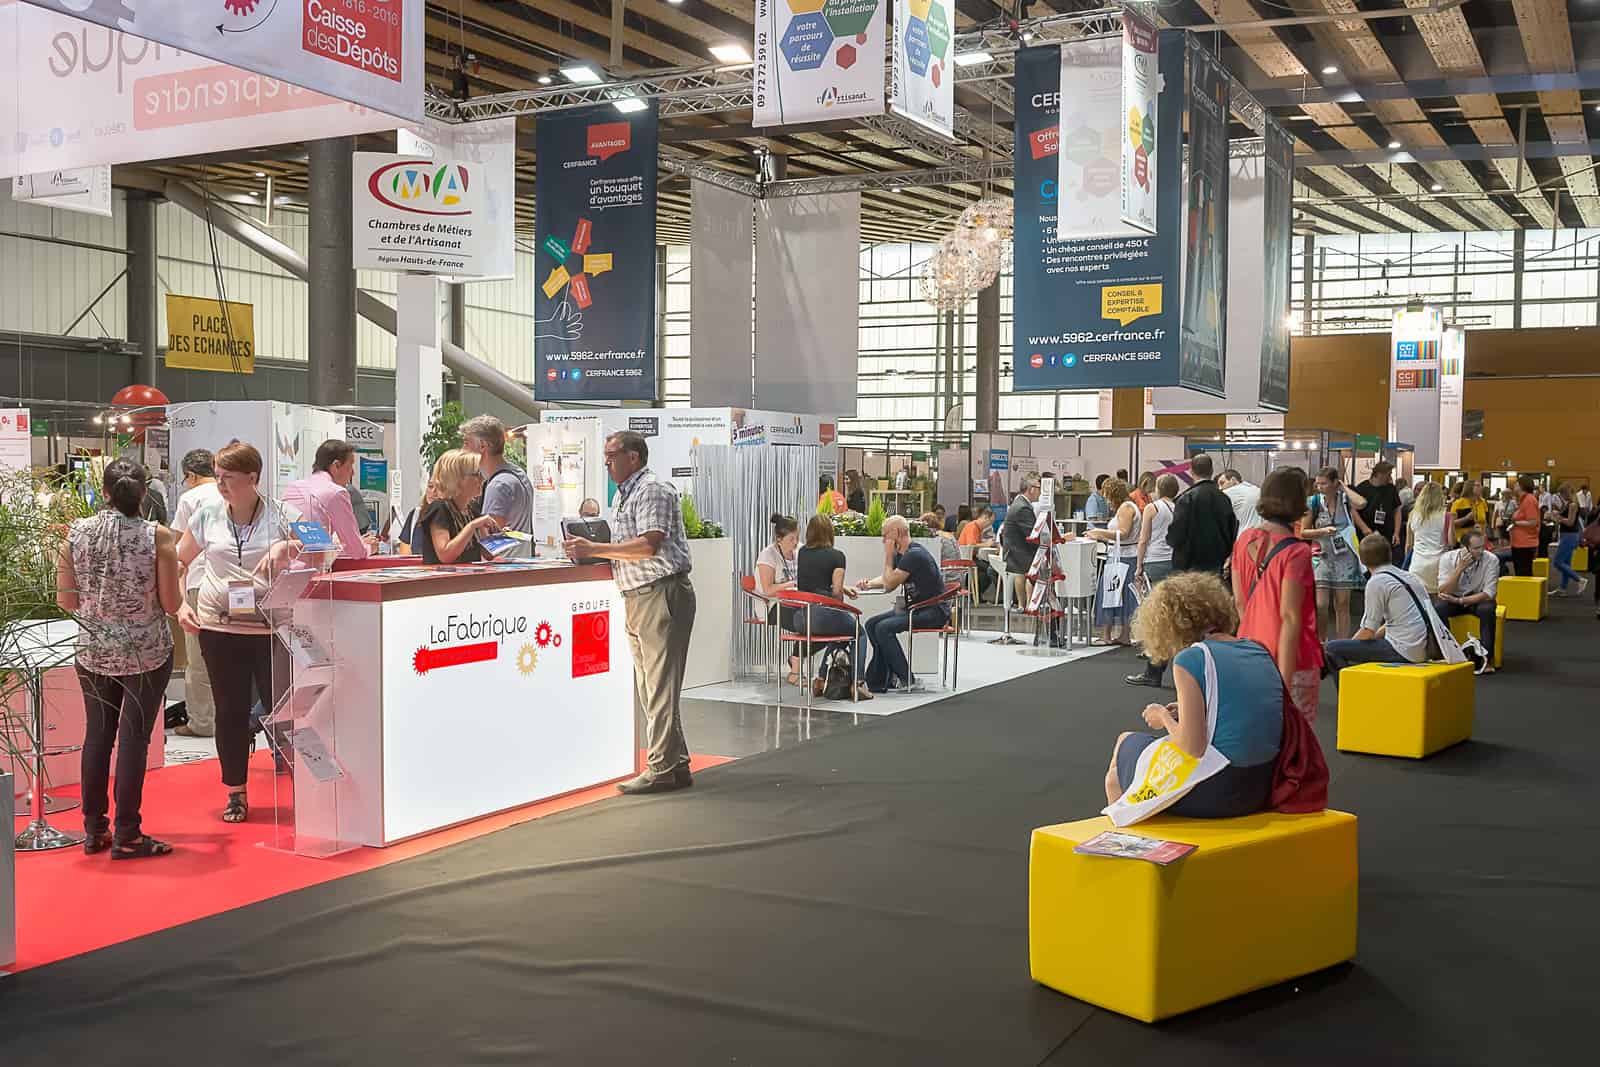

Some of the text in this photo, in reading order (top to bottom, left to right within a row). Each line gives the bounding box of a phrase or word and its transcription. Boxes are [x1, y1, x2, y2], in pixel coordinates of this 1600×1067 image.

[825, 3, 875, 16] l'installation
[303, 0, 367, 39] Caisse
[796, 21, 817, 31] votre
[788, 32, 823, 44] parcours
[302, 23, 398, 74] desDépôts
[757, 32, 767, 108] 09 72 72 59 62
[1031, 92, 1060, 108] CER
[1037, 131, 1059, 143] Offr
[589, 181, 643, 195] un bouquet
[367, 218, 473, 238] Chambres de Métiers
[380, 234, 462, 249] et de l'Artisanat
[1058, 244, 1086, 255] chèque
[1086, 242, 1113, 251] conseil
[1113, 241, 1125, 249] de
[1125, 239, 1142, 248] 450
[1142, 239, 1149, 247] €
[400, 255, 465, 269] Hauts-de-France
[1061, 253, 1103, 263] rencontres
[1064, 265, 1079, 273] nos
[1079, 263, 1110, 273] experts
[1107, 289, 1136, 297] CONSEIL
[1107, 297, 1145, 306] EXPERTISE
[1107, 305, 1150, 314] COMPTABLE
[192, 313, 228, 335] PLACE
[168, 333, 191, 353] DES
[1028, 328, 1165, 345] www.5962.cerfrance.fr
[1082, 351, 1161, 363] CERFRANCE 5962
[571, 599, 611, 613] GROUPE
[430, 612, 528, 646] LaFabrique
